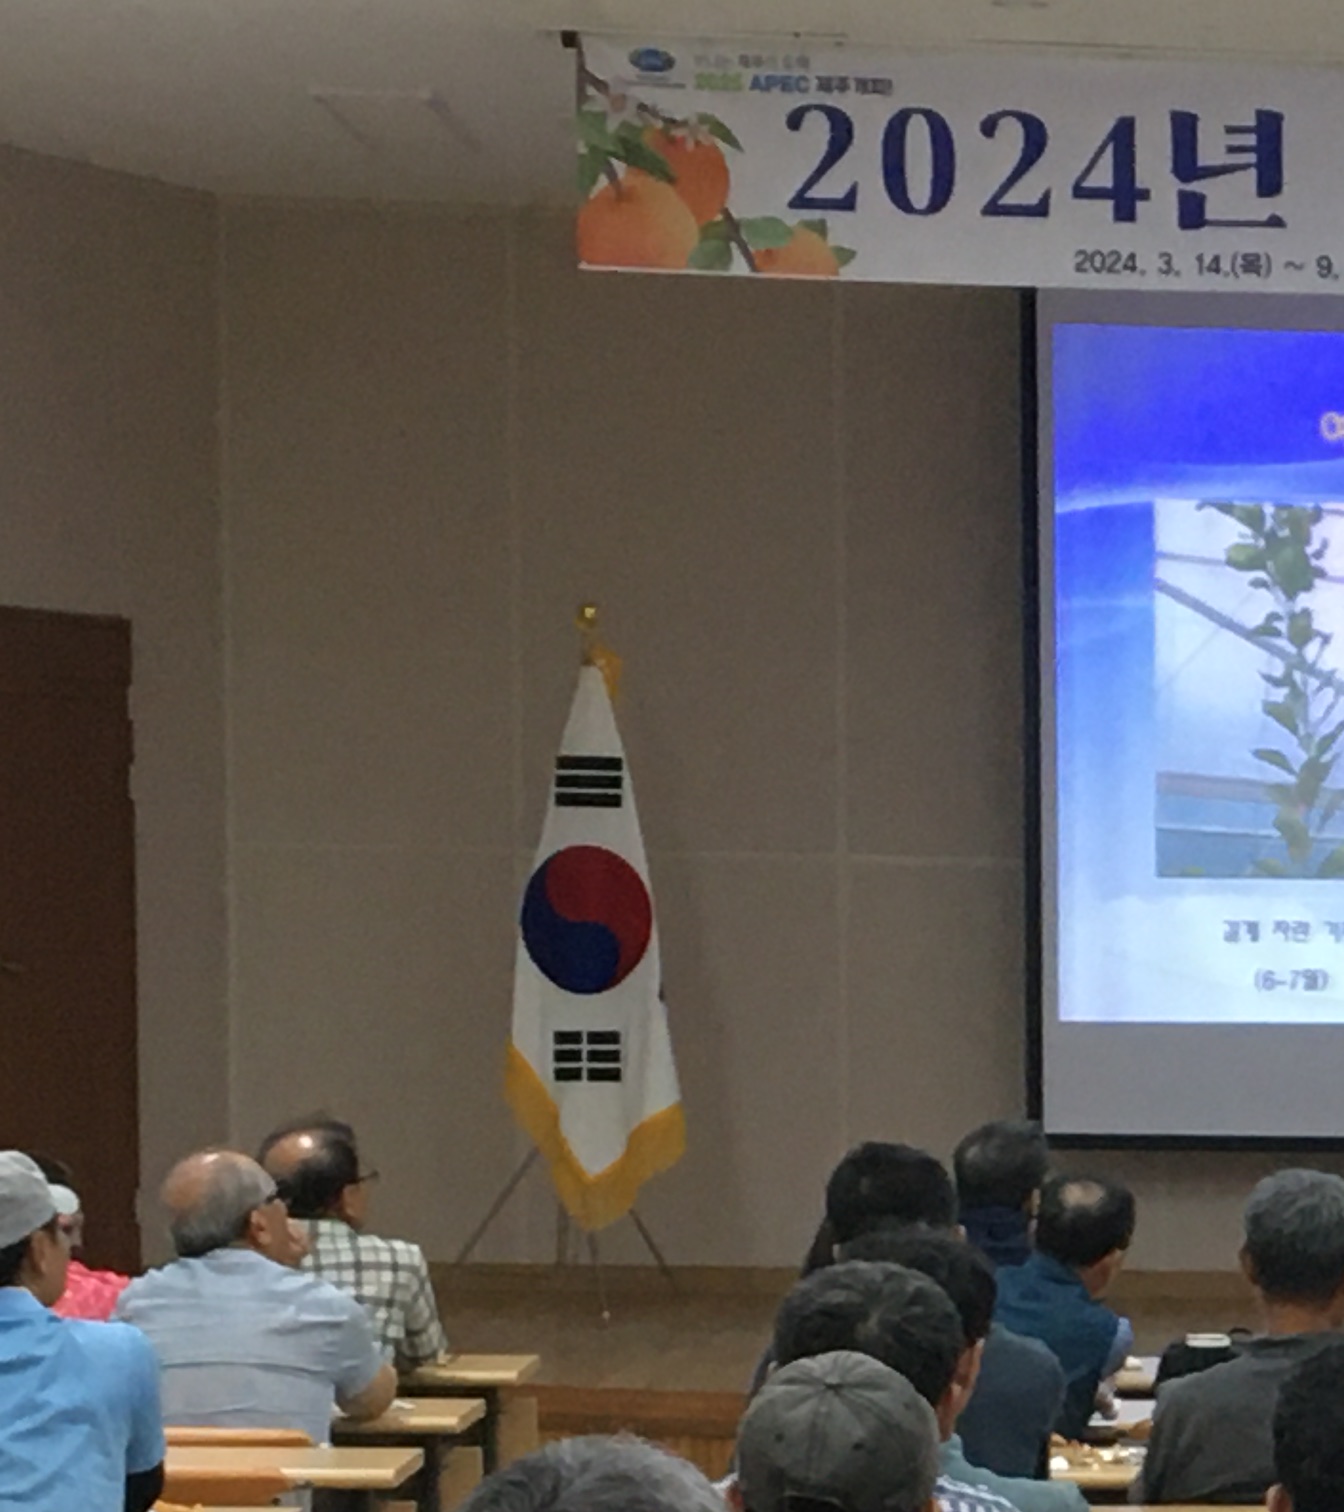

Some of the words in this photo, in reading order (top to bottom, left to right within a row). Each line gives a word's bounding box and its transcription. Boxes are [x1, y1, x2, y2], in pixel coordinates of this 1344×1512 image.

[784, 102, 1287, 231] 2024년
[1073, 248, 1147, 277] 2024.
[1157, 251, 1181, 278] 3.
[1194, 250, 1273, 281] 14.(목)
[1314, 254, 1340, 281] 9.
